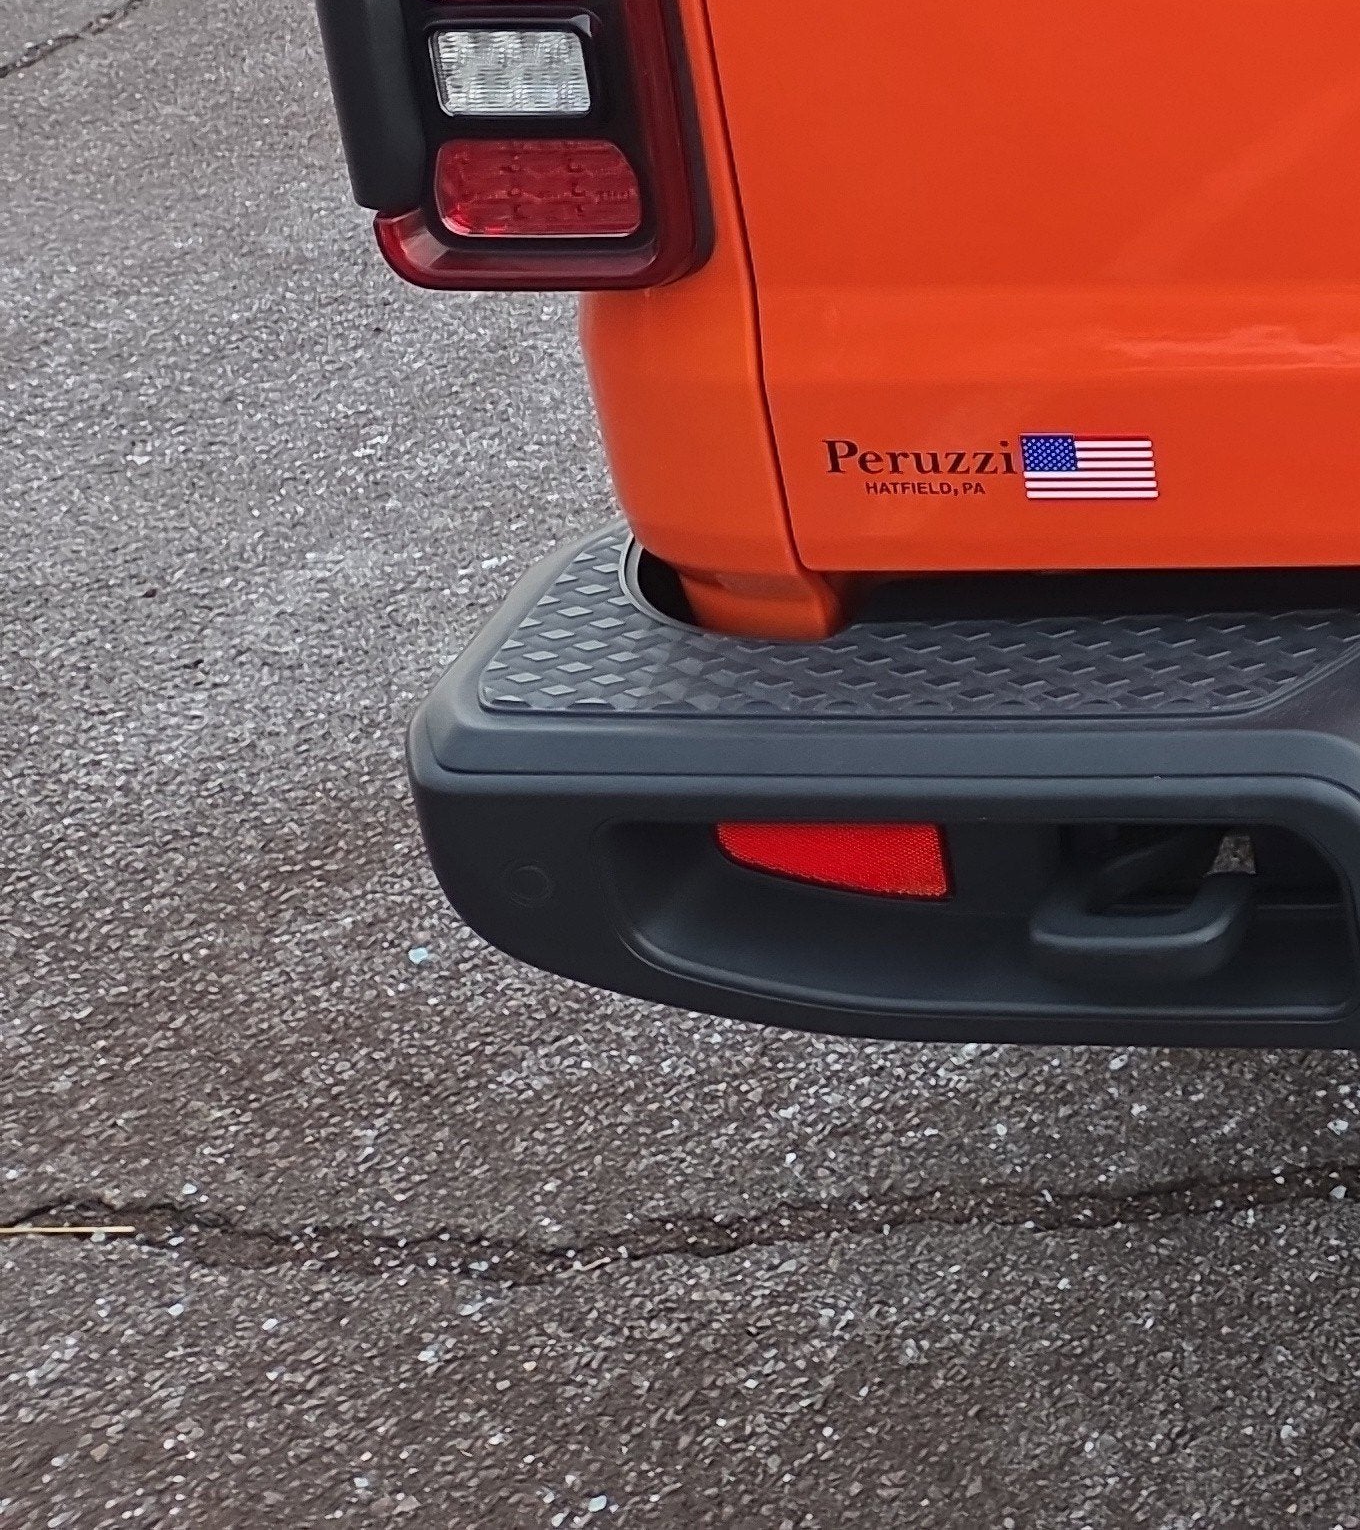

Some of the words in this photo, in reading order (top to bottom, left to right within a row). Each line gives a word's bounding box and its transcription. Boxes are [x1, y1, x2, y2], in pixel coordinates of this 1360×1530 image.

[822, 439, 1017, 475] Peruzzi
[865, 481, 959, 496] HATFIELD,
[962, 481, 986, 495] PA
